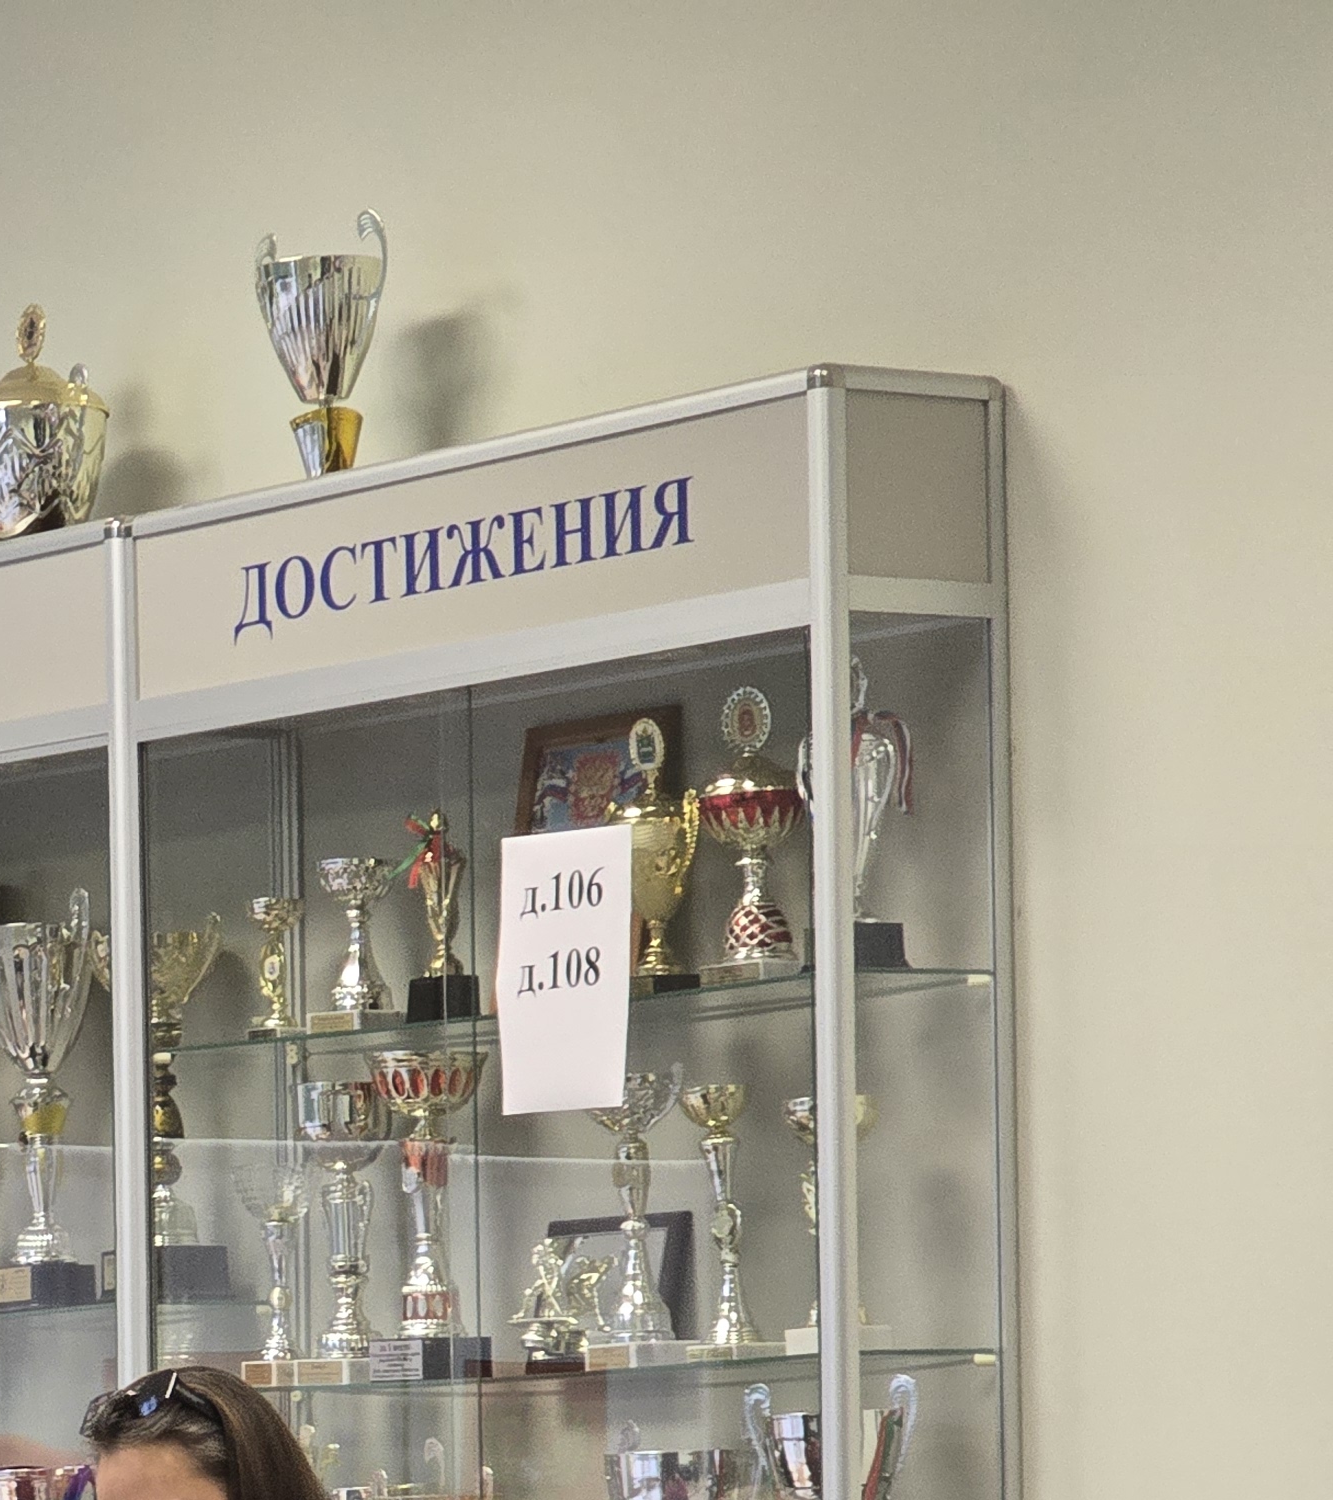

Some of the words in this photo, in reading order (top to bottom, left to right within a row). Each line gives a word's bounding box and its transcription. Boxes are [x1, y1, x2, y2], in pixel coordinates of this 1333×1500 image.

[233, 474, 695, 646] ДОСТИЖЕНИЯ
[520, 866, 605, 919] д.106
[517, 946, 601, 998] д.108
